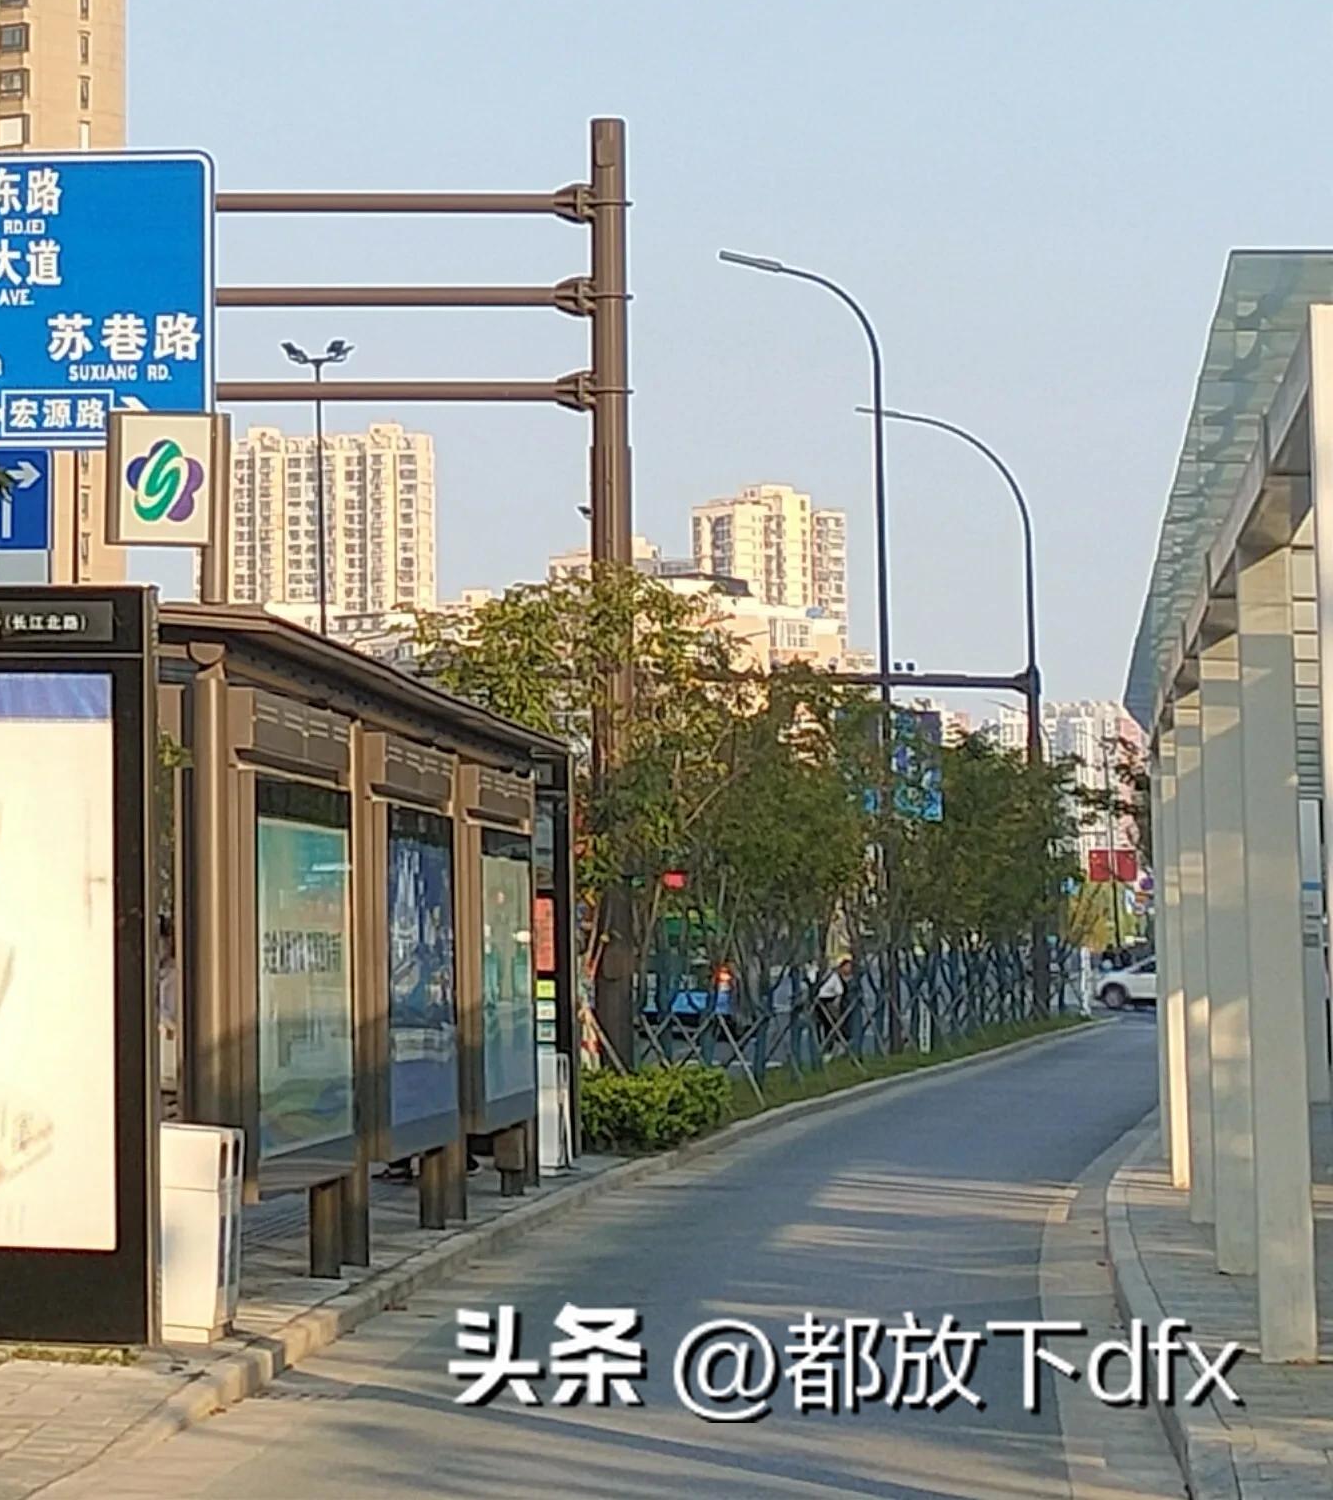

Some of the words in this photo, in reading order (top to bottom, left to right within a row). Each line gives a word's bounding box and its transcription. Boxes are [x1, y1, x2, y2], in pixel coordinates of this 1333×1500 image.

[47, 312, 202, 362] 苏巷路
[67, 363, 139, 382] SUXIANG
[146, 363, 173, 382] RD.
[8, 397, 106, 430] 宏源路
